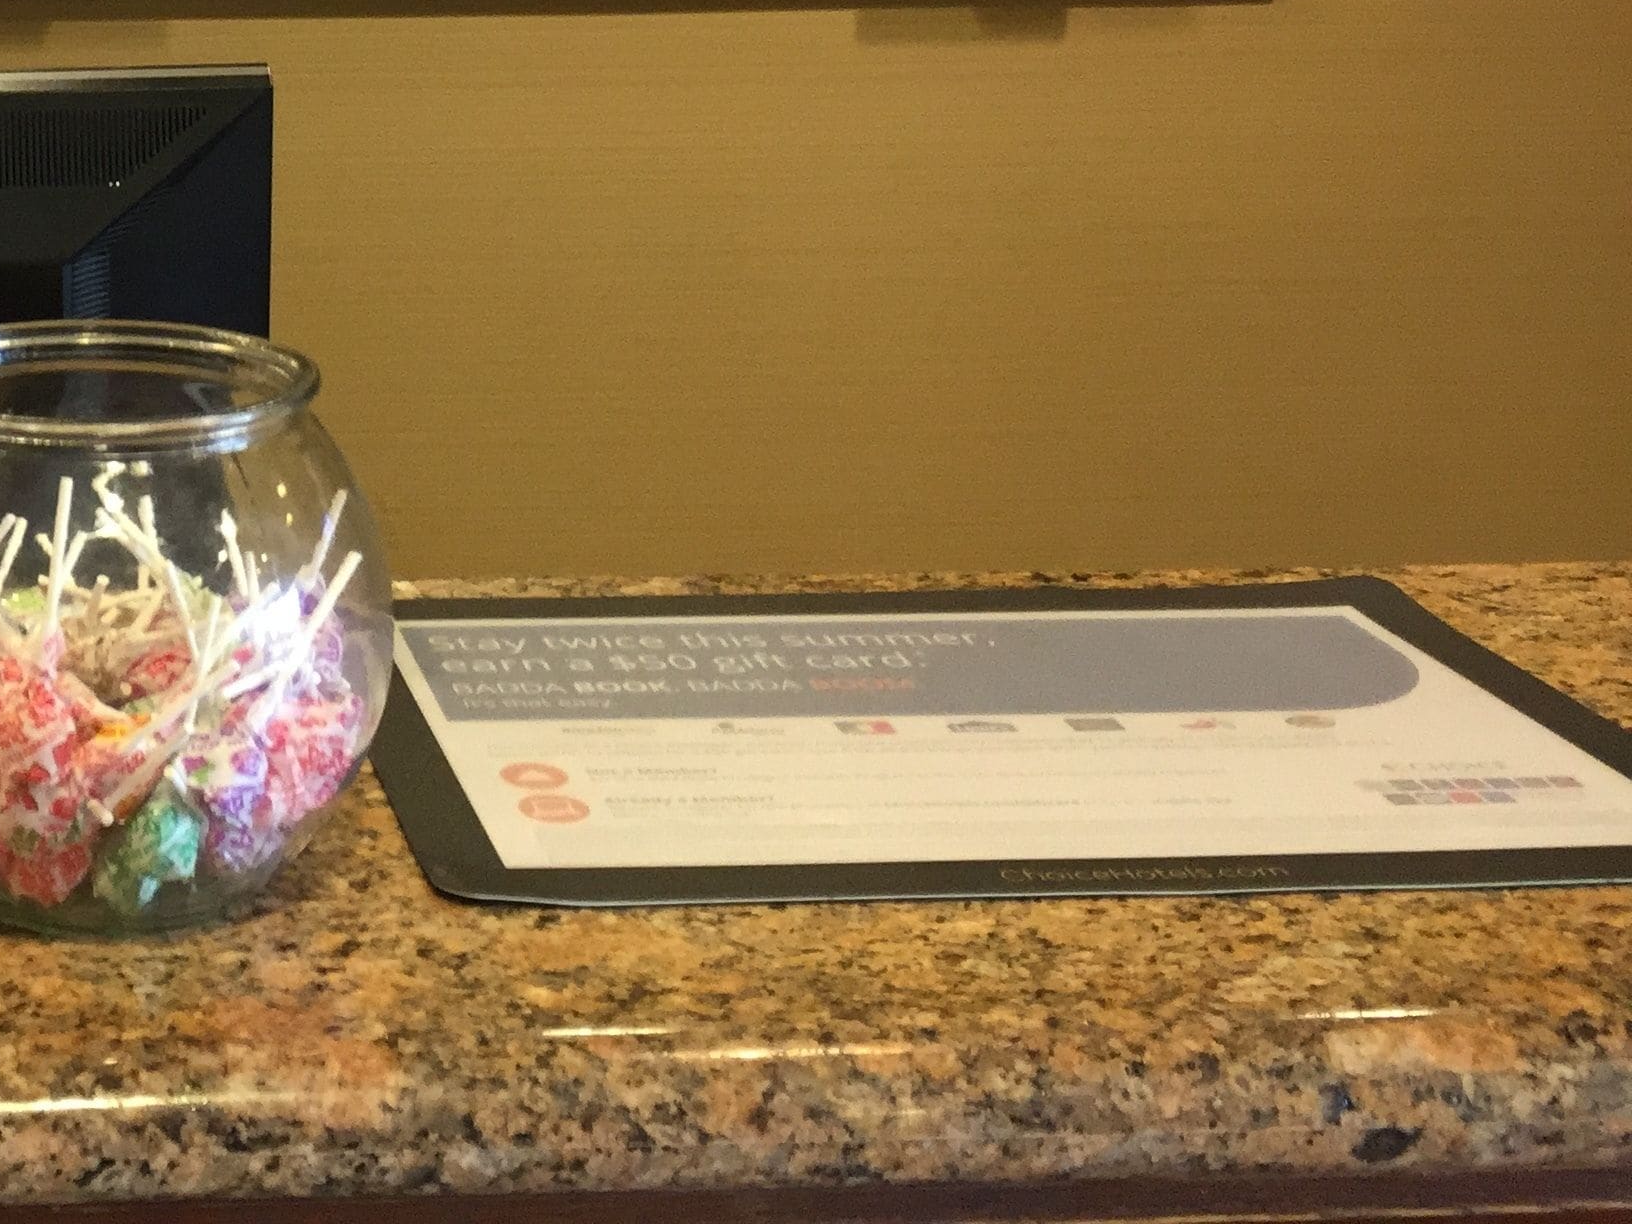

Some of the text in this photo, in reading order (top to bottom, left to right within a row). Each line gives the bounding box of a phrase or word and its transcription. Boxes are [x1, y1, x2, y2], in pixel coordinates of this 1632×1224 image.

[428, 634, 526, 654] Stay
[542, 634, 666, 650] twice
[679, 631, 768, 650] this
[440, 656, 551, 673] earn
[568, 656, 595, 672] a
[608, 654, 698, 673] $50
